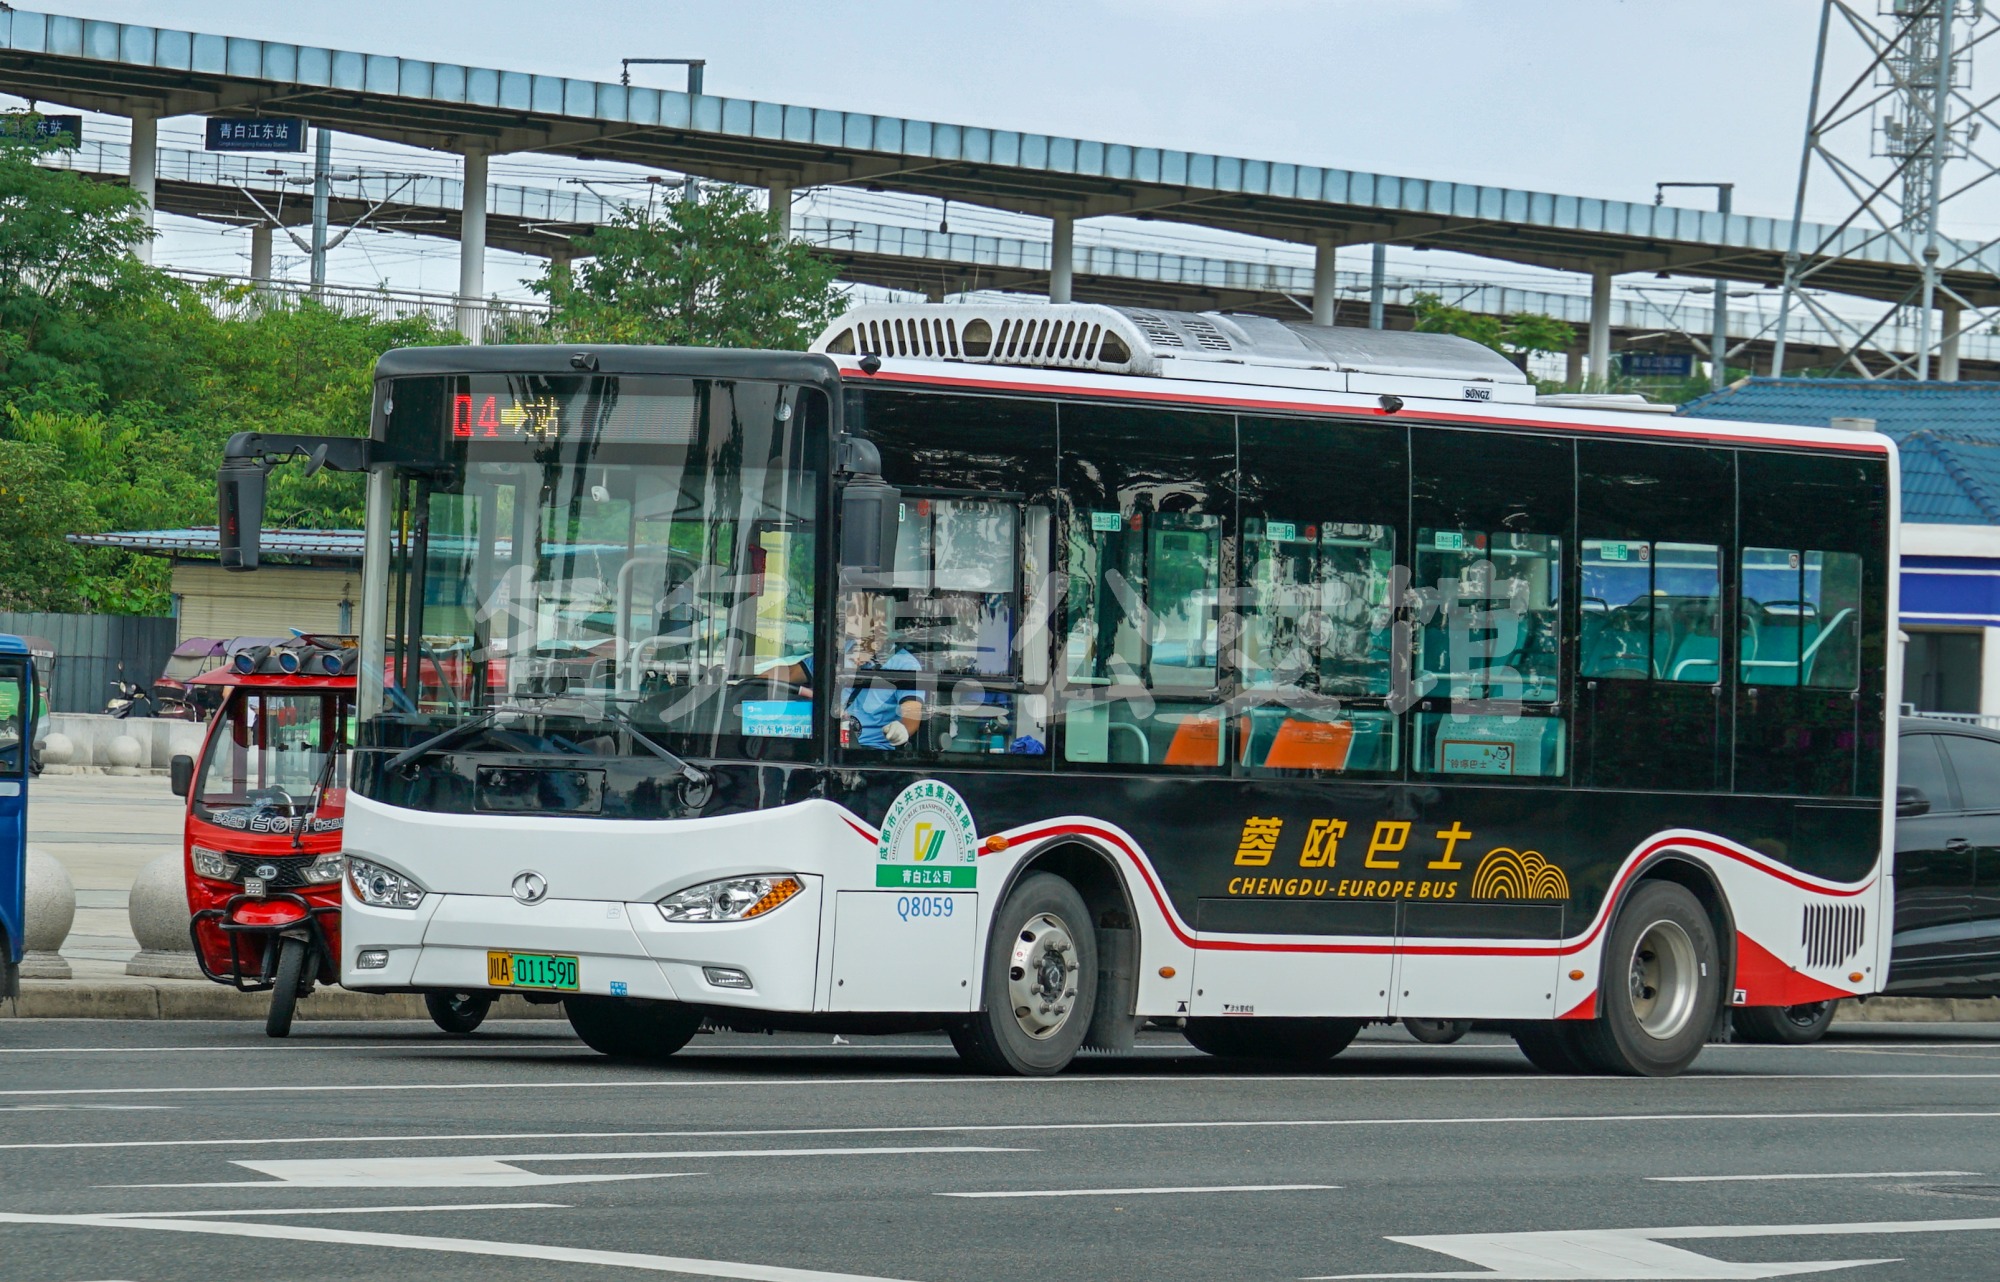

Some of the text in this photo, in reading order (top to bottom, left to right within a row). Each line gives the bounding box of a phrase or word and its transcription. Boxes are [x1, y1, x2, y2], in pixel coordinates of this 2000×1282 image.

[220, 122, 289, 140] 青白江东站
[1465, 388, 1490, 400] SONGZ
[453, 394, 500, 437] Q4
[879, 783, 976, 863] 成都市公共交通集团有限公司
[1233, 816, 1472, 870] 蓉欧巴士
[902, 869, 952, 884] 青白江公司
[1228, 877, 1458, 898] CHENGDU-EUROPE BUS
[897, 896, 954, 922] Q8059
